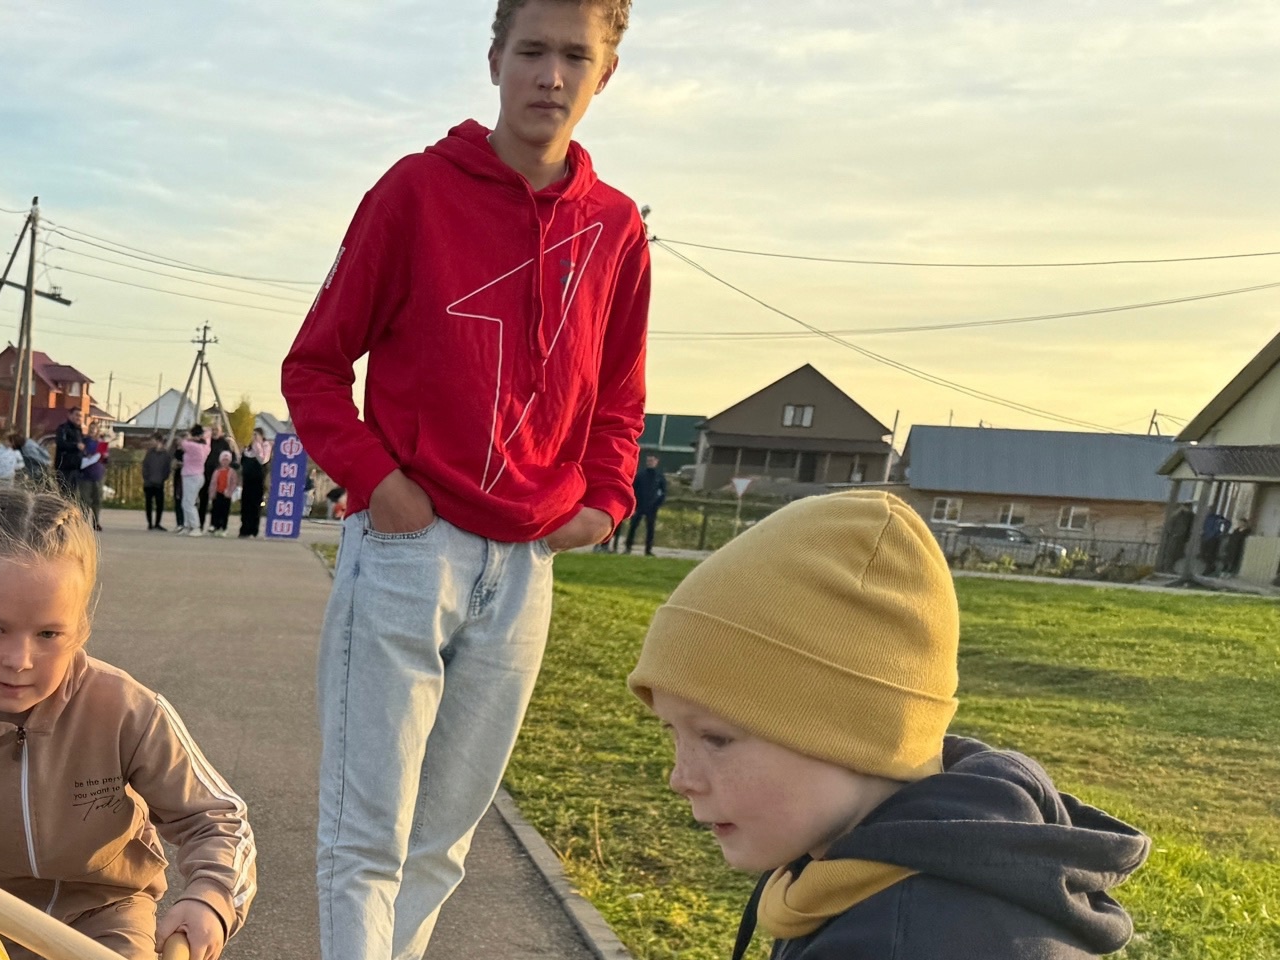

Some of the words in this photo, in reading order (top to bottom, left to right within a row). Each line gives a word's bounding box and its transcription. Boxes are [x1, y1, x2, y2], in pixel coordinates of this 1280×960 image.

[271, 436, 303, 535] ФИНИШ
[74, 780, 84, 788] be
[86, 779, 99, 787] the
[90, 787, 109, 796] want
